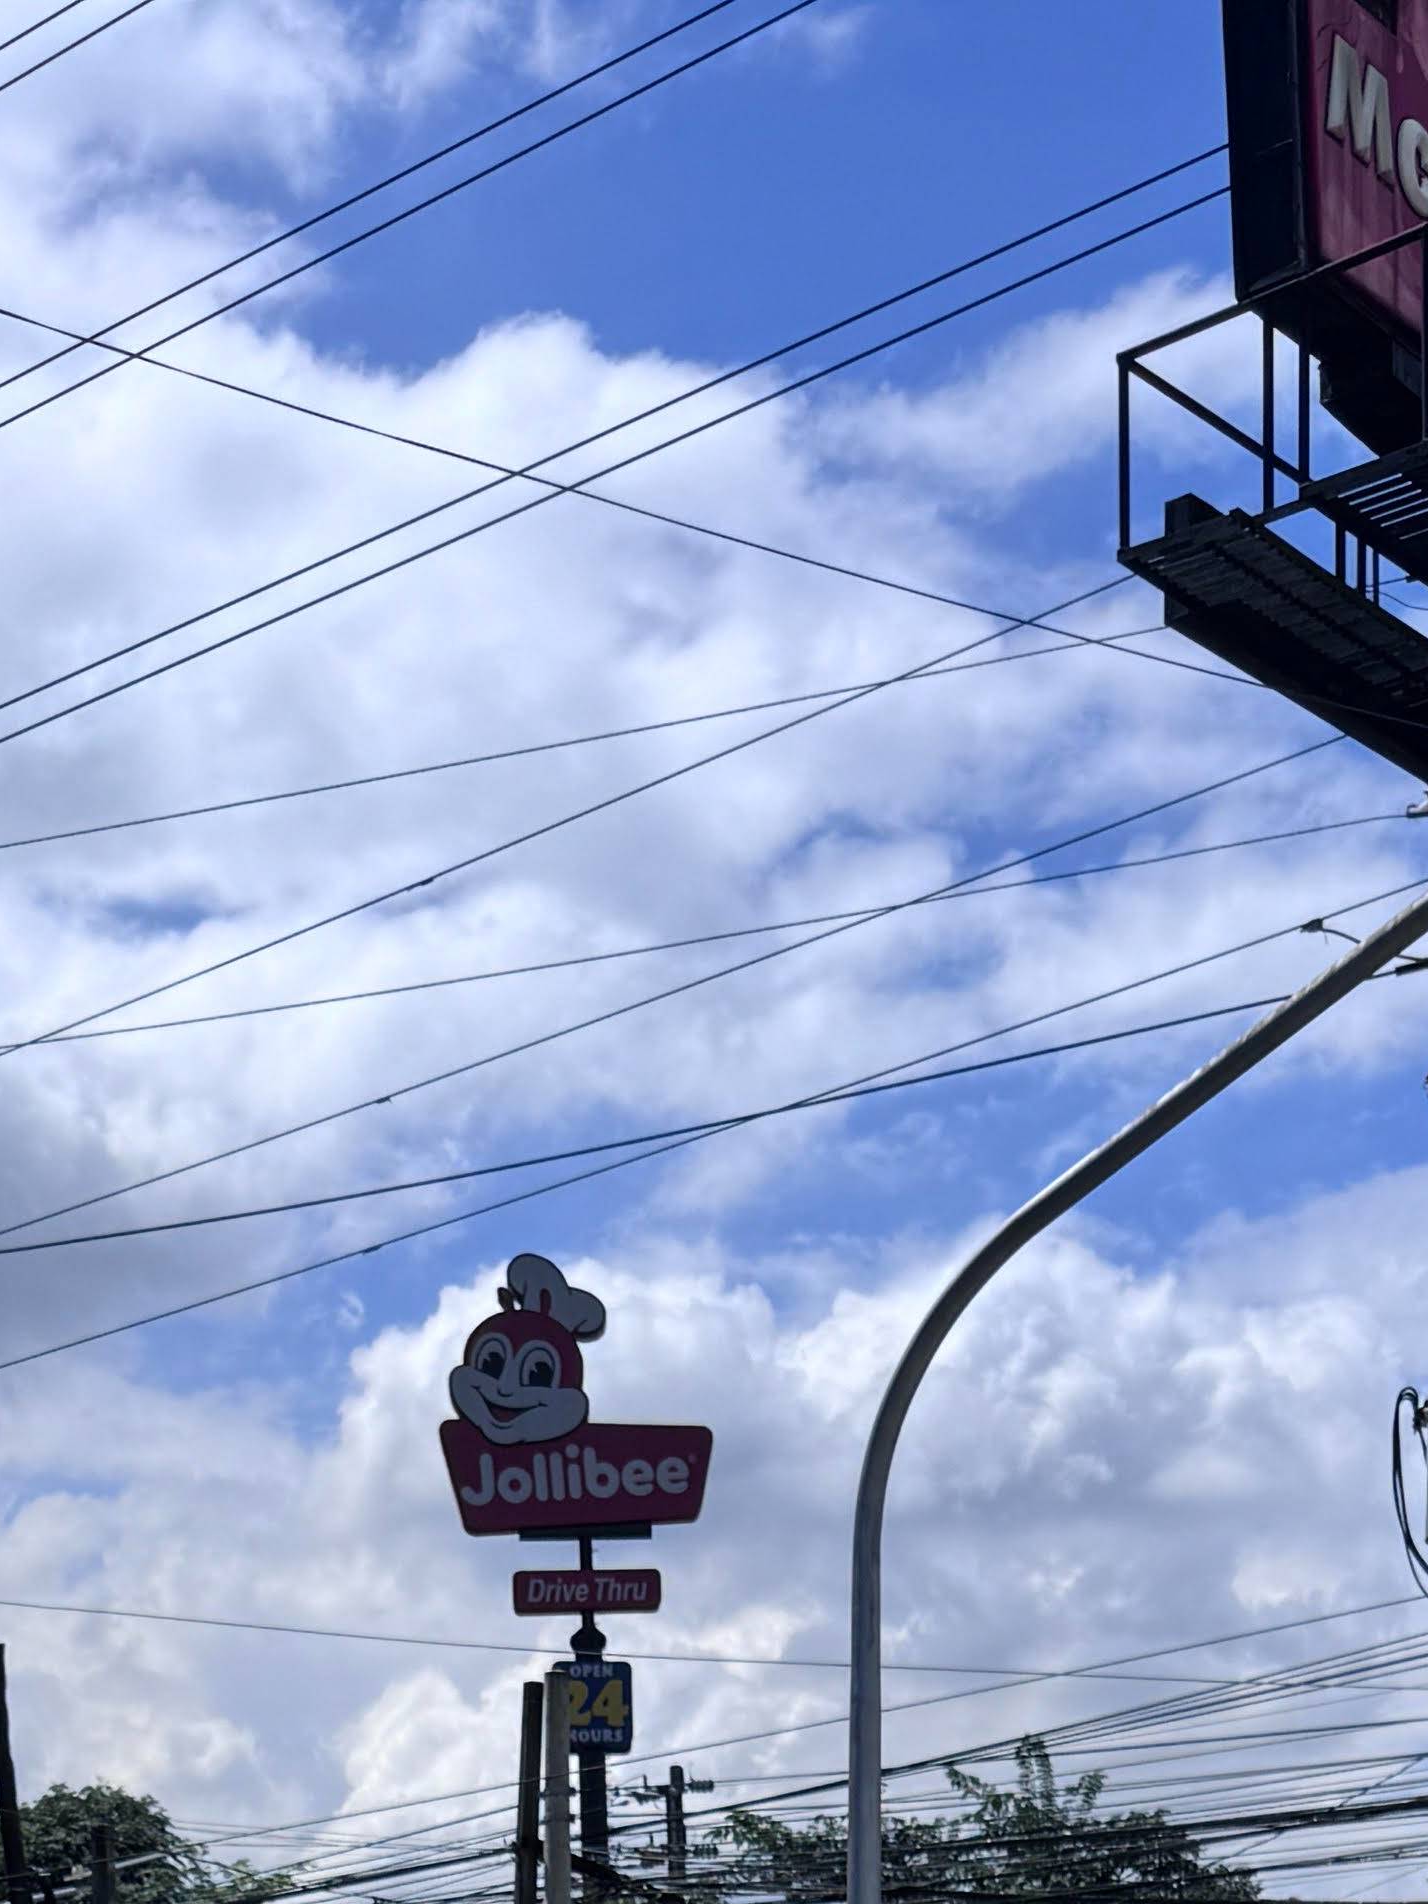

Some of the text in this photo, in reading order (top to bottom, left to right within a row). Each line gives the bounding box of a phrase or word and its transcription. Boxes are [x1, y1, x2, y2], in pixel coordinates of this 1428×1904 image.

[460, 1444, 690, 1506] Jollibee
[527, 1577, 647, 1604] Drive Thru
[569, 1663, 614, 1678] OPEN
[568, 1680, 629, 1727] 24
